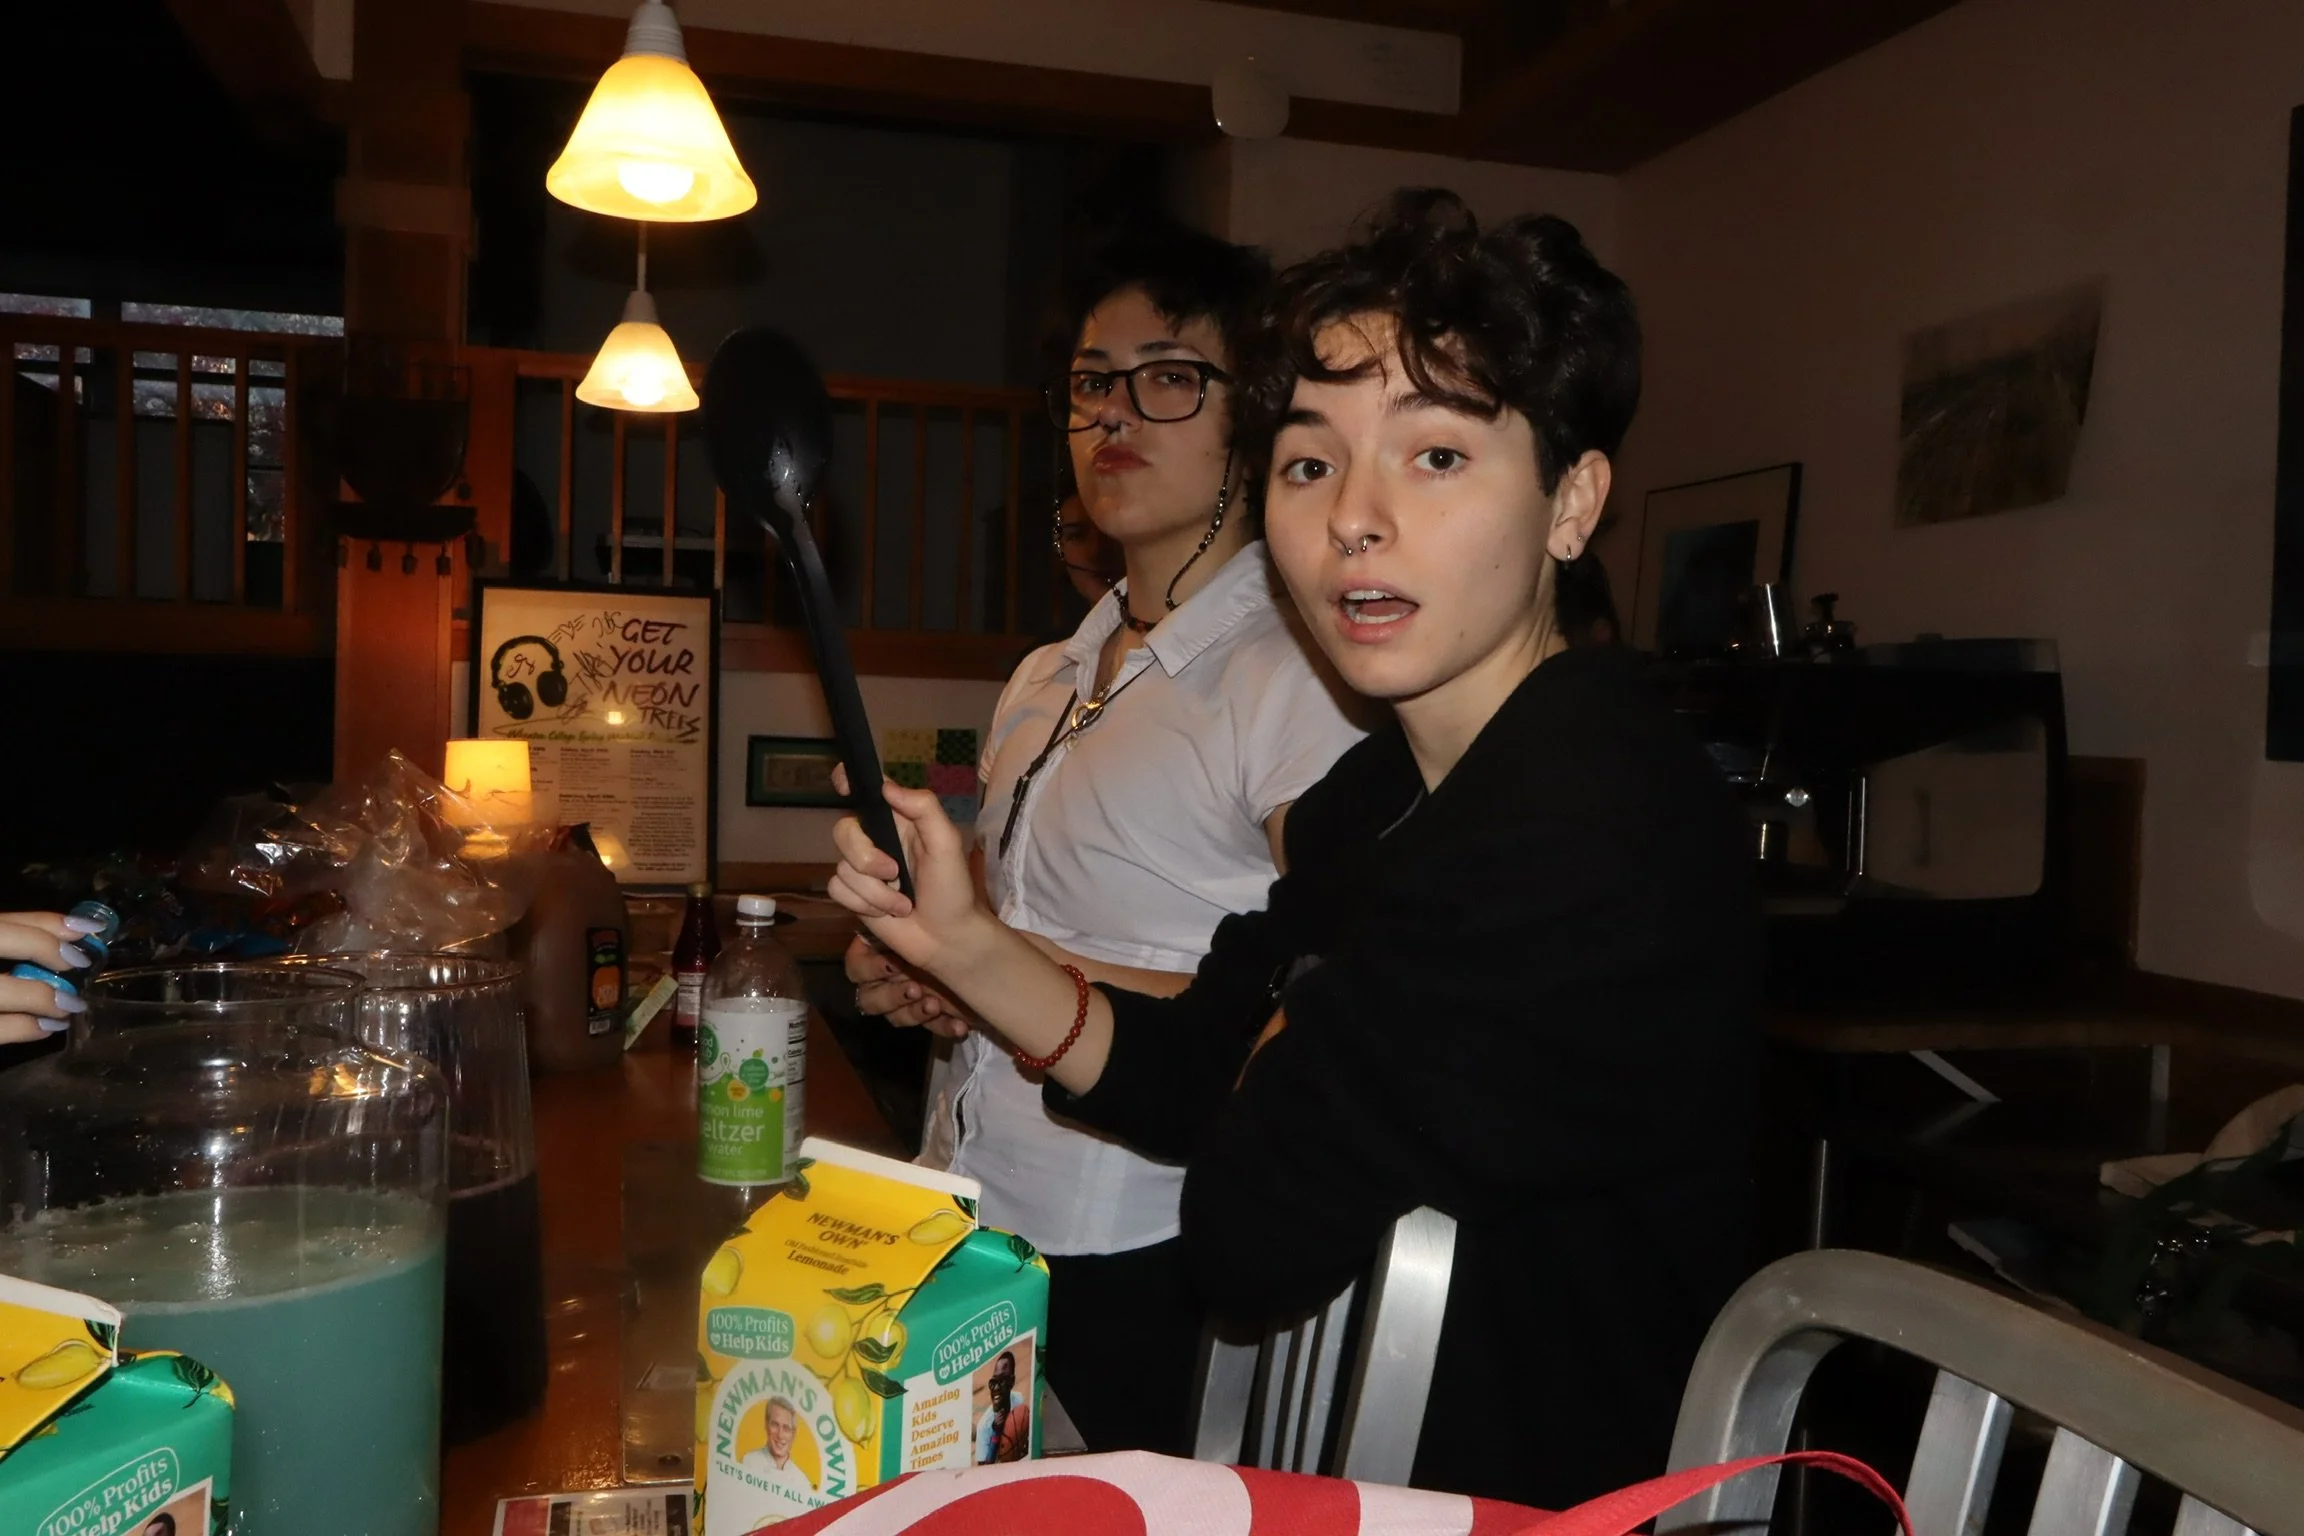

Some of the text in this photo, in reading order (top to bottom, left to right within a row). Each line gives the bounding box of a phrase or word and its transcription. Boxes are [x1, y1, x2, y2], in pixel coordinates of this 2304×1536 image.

[621, 618, 688, 645] GET
[610, 645, 695, 676] YOUR
[603, 680, 700, 708] NEON
[638, 706, 701, 739] TREES
[732, 1103, 764, 1118] lime
[702, 1118, 766, 1142] eltzer
[707, 1143, 743, 1156] water
[807, 1212, 900, 1246] NEWMAN'S
[818, 1230, 864, 1250] OWN
[786, 1250, 850, 1275] Lemonade
[712, 1313, 789, 1334] 100% Profits
[939, 1308, 1010, 1363] 100% Profits
[722, 1333, 790, 1354] Help Kids
[951, 1325, 1013, 1374] Help Kids
[912, 1387, 960, 1413] Amazing
[911, 1411, 937, 1428] Kids
[911, 1419, 955, 1442] Deserve
[716, 1368, 846, 1498] NEWMAN'S OWN
[910, 1430, 960, 1456] Amazing
[911, 1451, 944, 1470] Times
[102, 1456, 168, 1509] Profits
[745, 1473, 769, 1492] GIVE
[771, 1484, 781, 1495] IT
[784, 1489, 803, 1504] ALL
[123, 1478, 173, 1520] Kids
